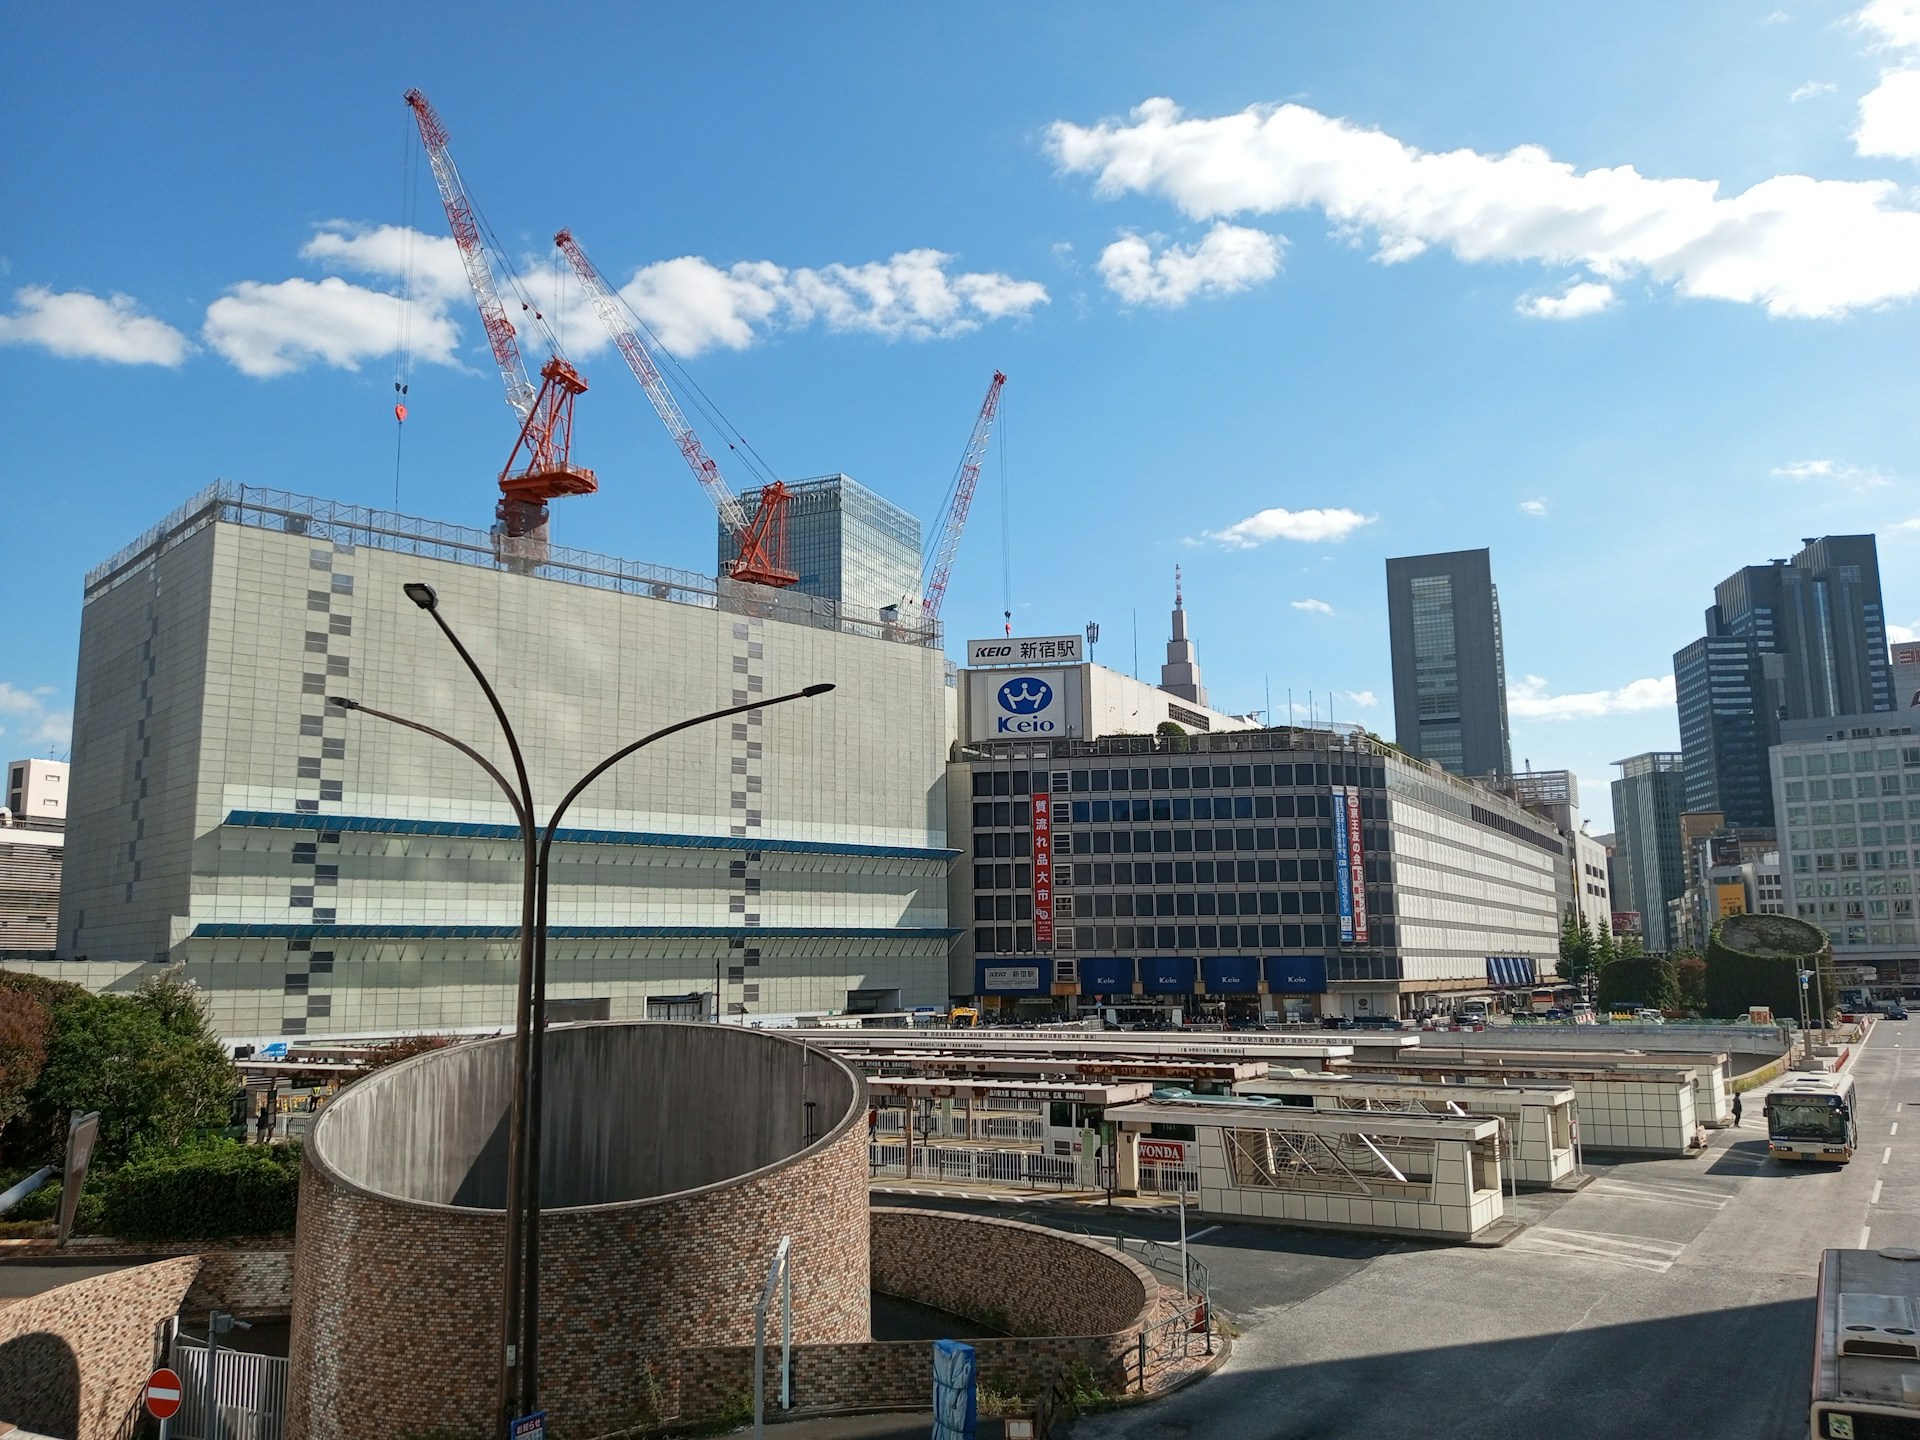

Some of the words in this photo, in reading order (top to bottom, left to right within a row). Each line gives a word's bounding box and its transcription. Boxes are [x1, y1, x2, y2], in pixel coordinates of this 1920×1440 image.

[975, 646, 1012, 658] KEIO
[1020, 640, 1075, 659] 新宿駅
[998, 715, 1054, 733] Keio
[1350, 808, 1362, 865] 京王友の会
[1035, 800, 1049, 902] 質流れ品大市
[1097, 977, 1115, 985] Keio
[1159, 976, 1177, 984] Keio
[1221, 976, 1240, 984] Keio
[1287, 976, 1307, 984] Keio
[1139, 1145, 1180, 1159] WONDA
[516, 1418, 541, 1435] お知らせ
